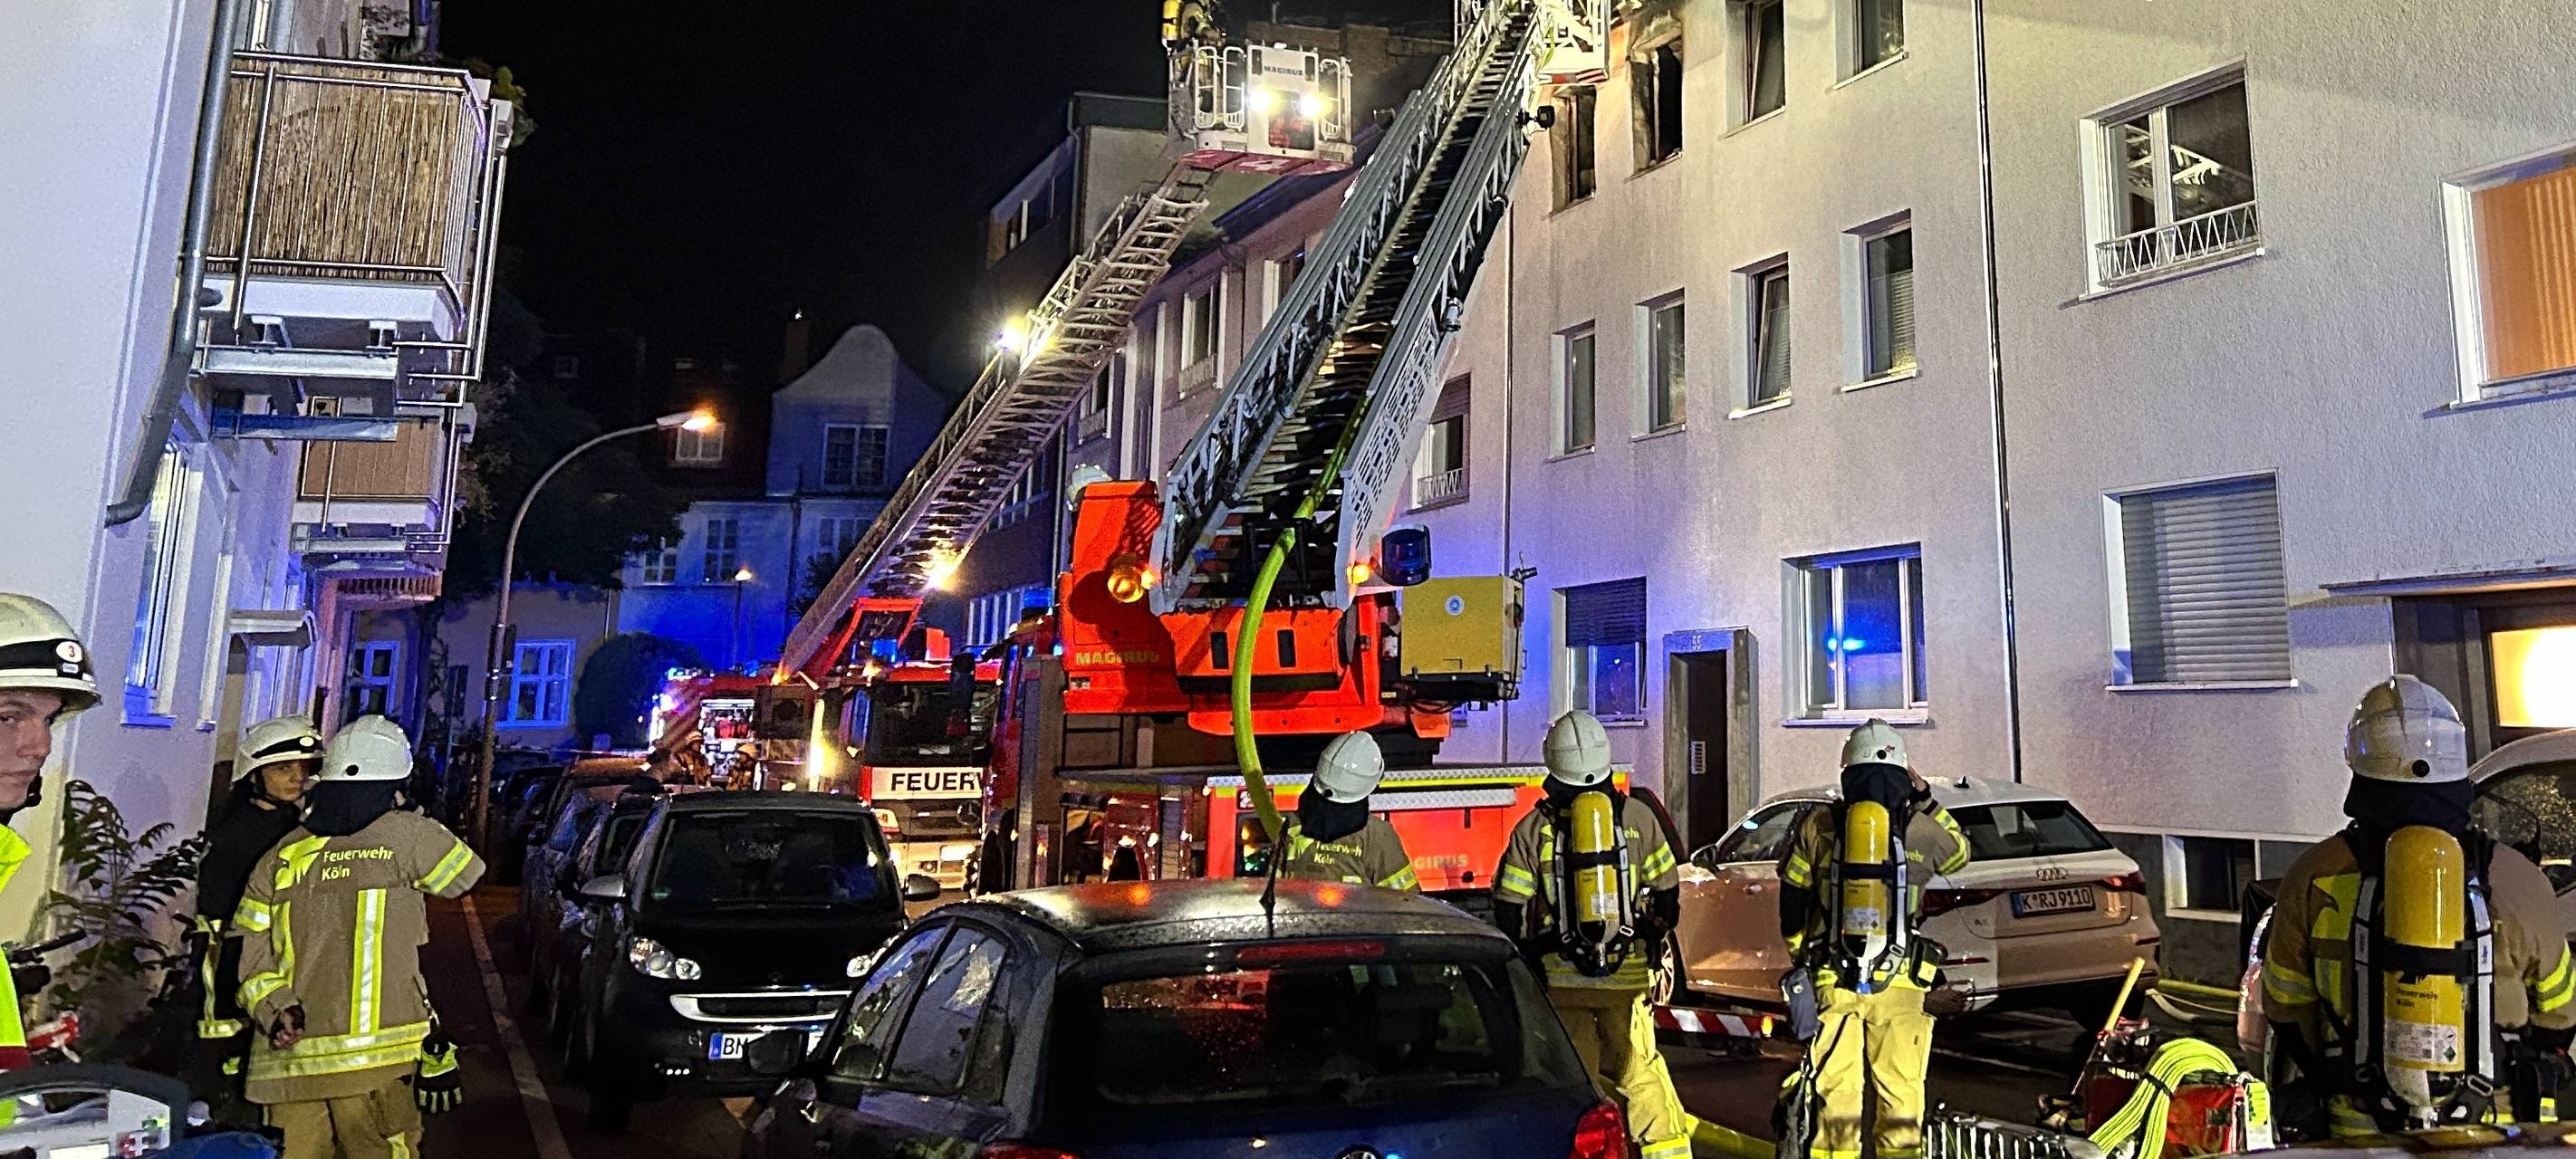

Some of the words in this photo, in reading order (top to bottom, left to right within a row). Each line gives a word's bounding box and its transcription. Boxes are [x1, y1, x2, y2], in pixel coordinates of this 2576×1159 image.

[1264, 65, 1303, 76] MAGIRUS
[68, 645, 75, 658] 3
[890, 771, 982, 791] FEUER
[323, 846, 393, 863] Feuerwehr
[1413, 855, 1468, 869] GIRUS
[322, 865, 351, 881] Köln
